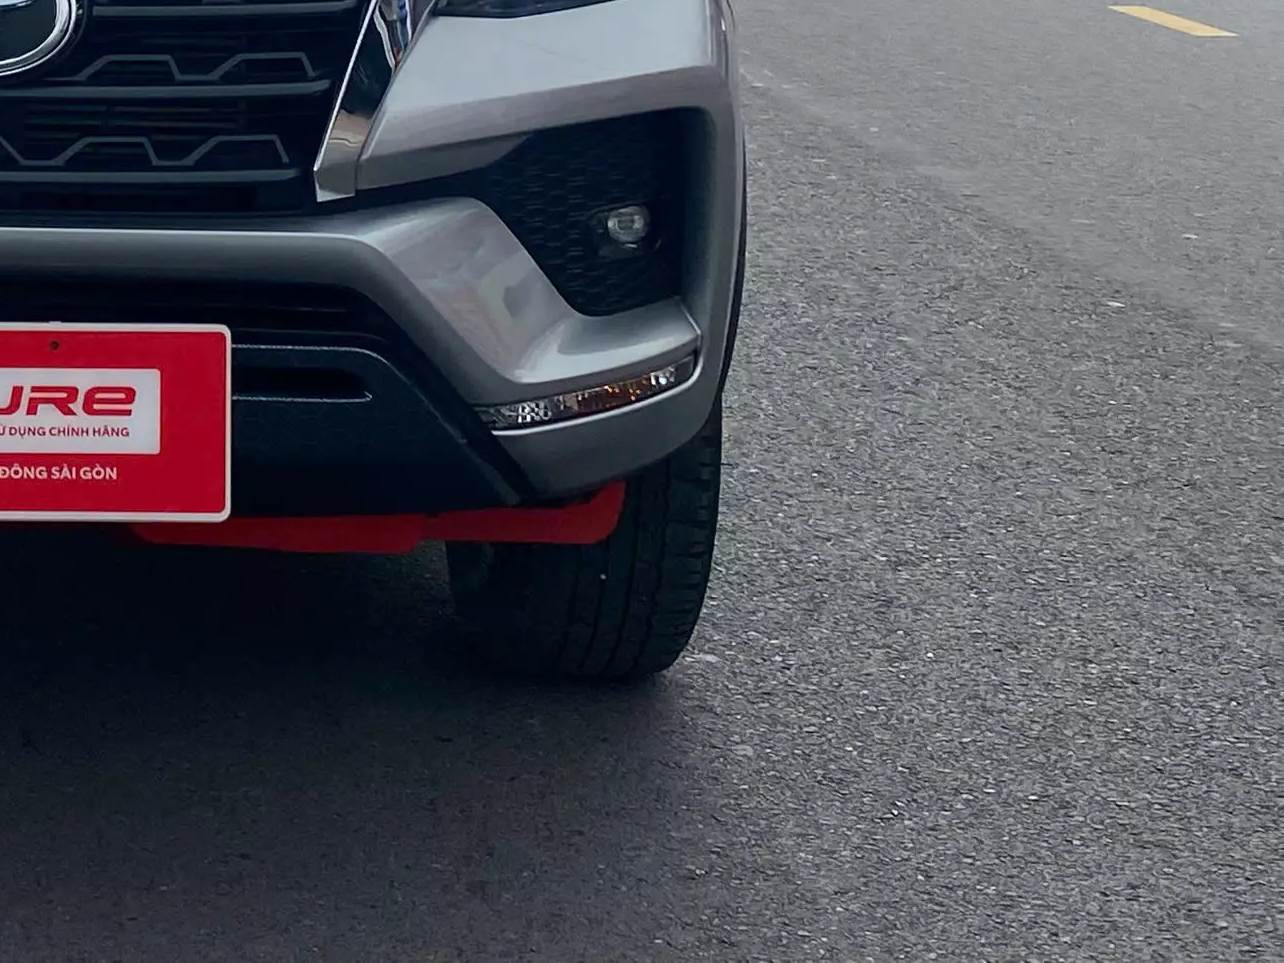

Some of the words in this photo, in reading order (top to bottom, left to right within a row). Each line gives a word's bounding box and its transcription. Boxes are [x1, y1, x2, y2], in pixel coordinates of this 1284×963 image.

[9, 426, 46, 439] DỤNG
[49, 424, 89, 438] CHÍNH
[92, 425, 130, 438] HÃNG
[51, 463, 77, 480] SÀI
[79, 463, 117, 480] GÒN
